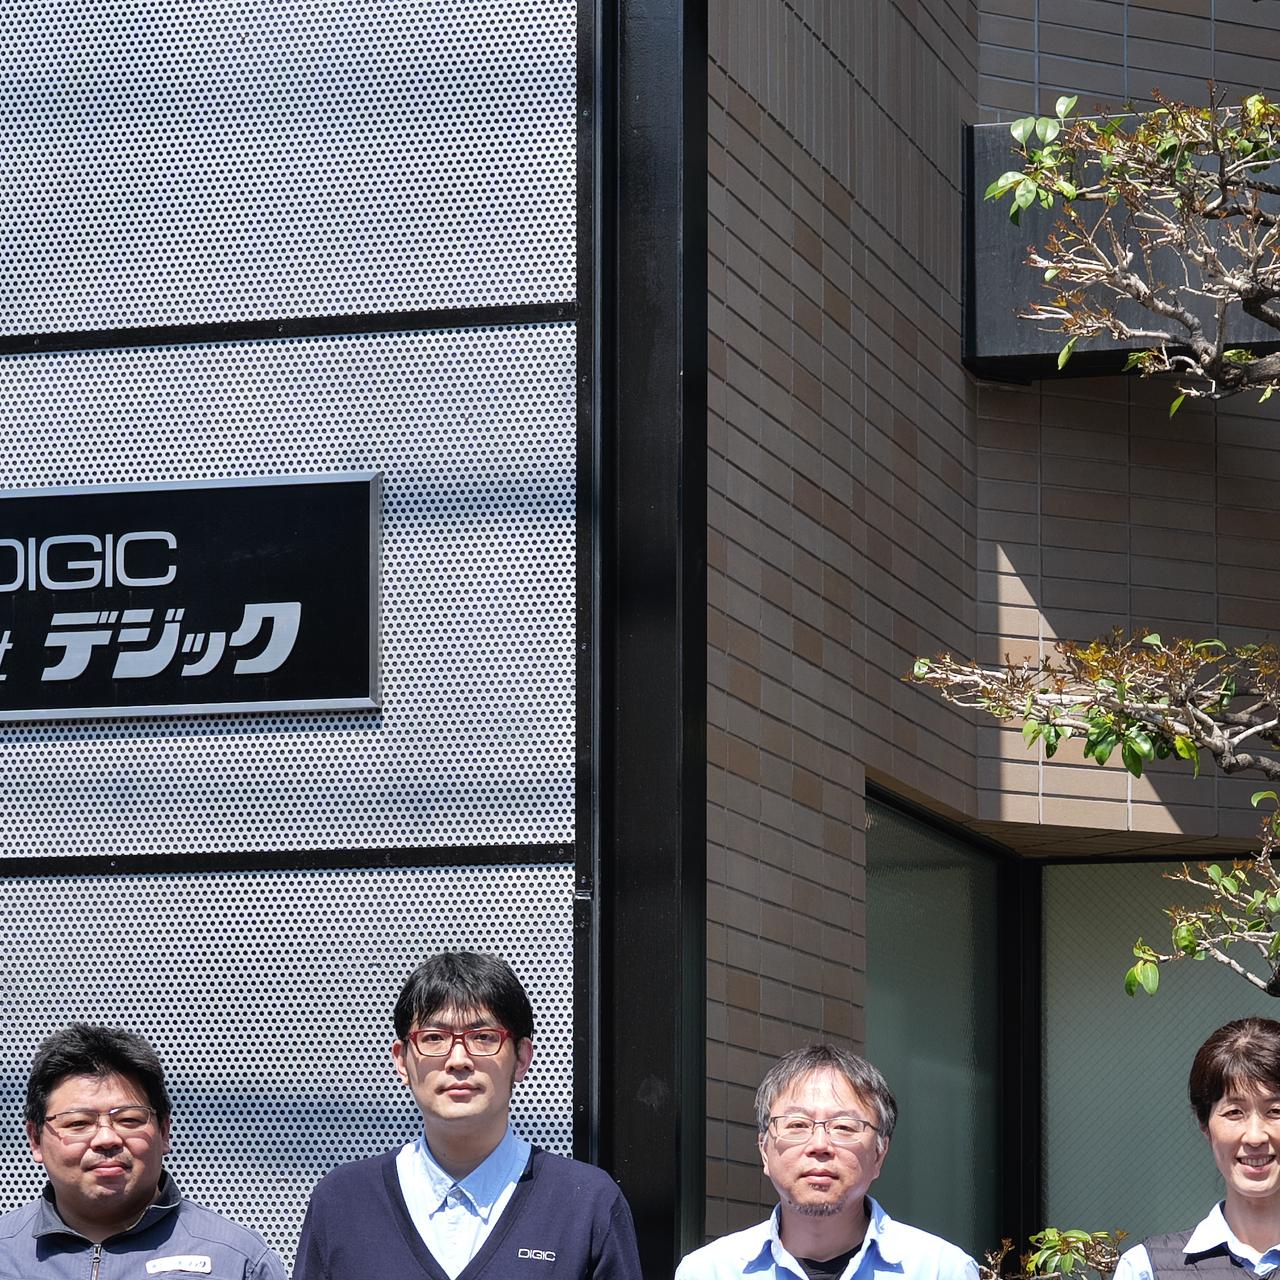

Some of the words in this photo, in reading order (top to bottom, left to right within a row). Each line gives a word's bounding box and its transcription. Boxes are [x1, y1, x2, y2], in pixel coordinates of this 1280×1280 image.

[40, 601, 302, 682] デジック
[517, 1248, 556, 1262] DIGIC
